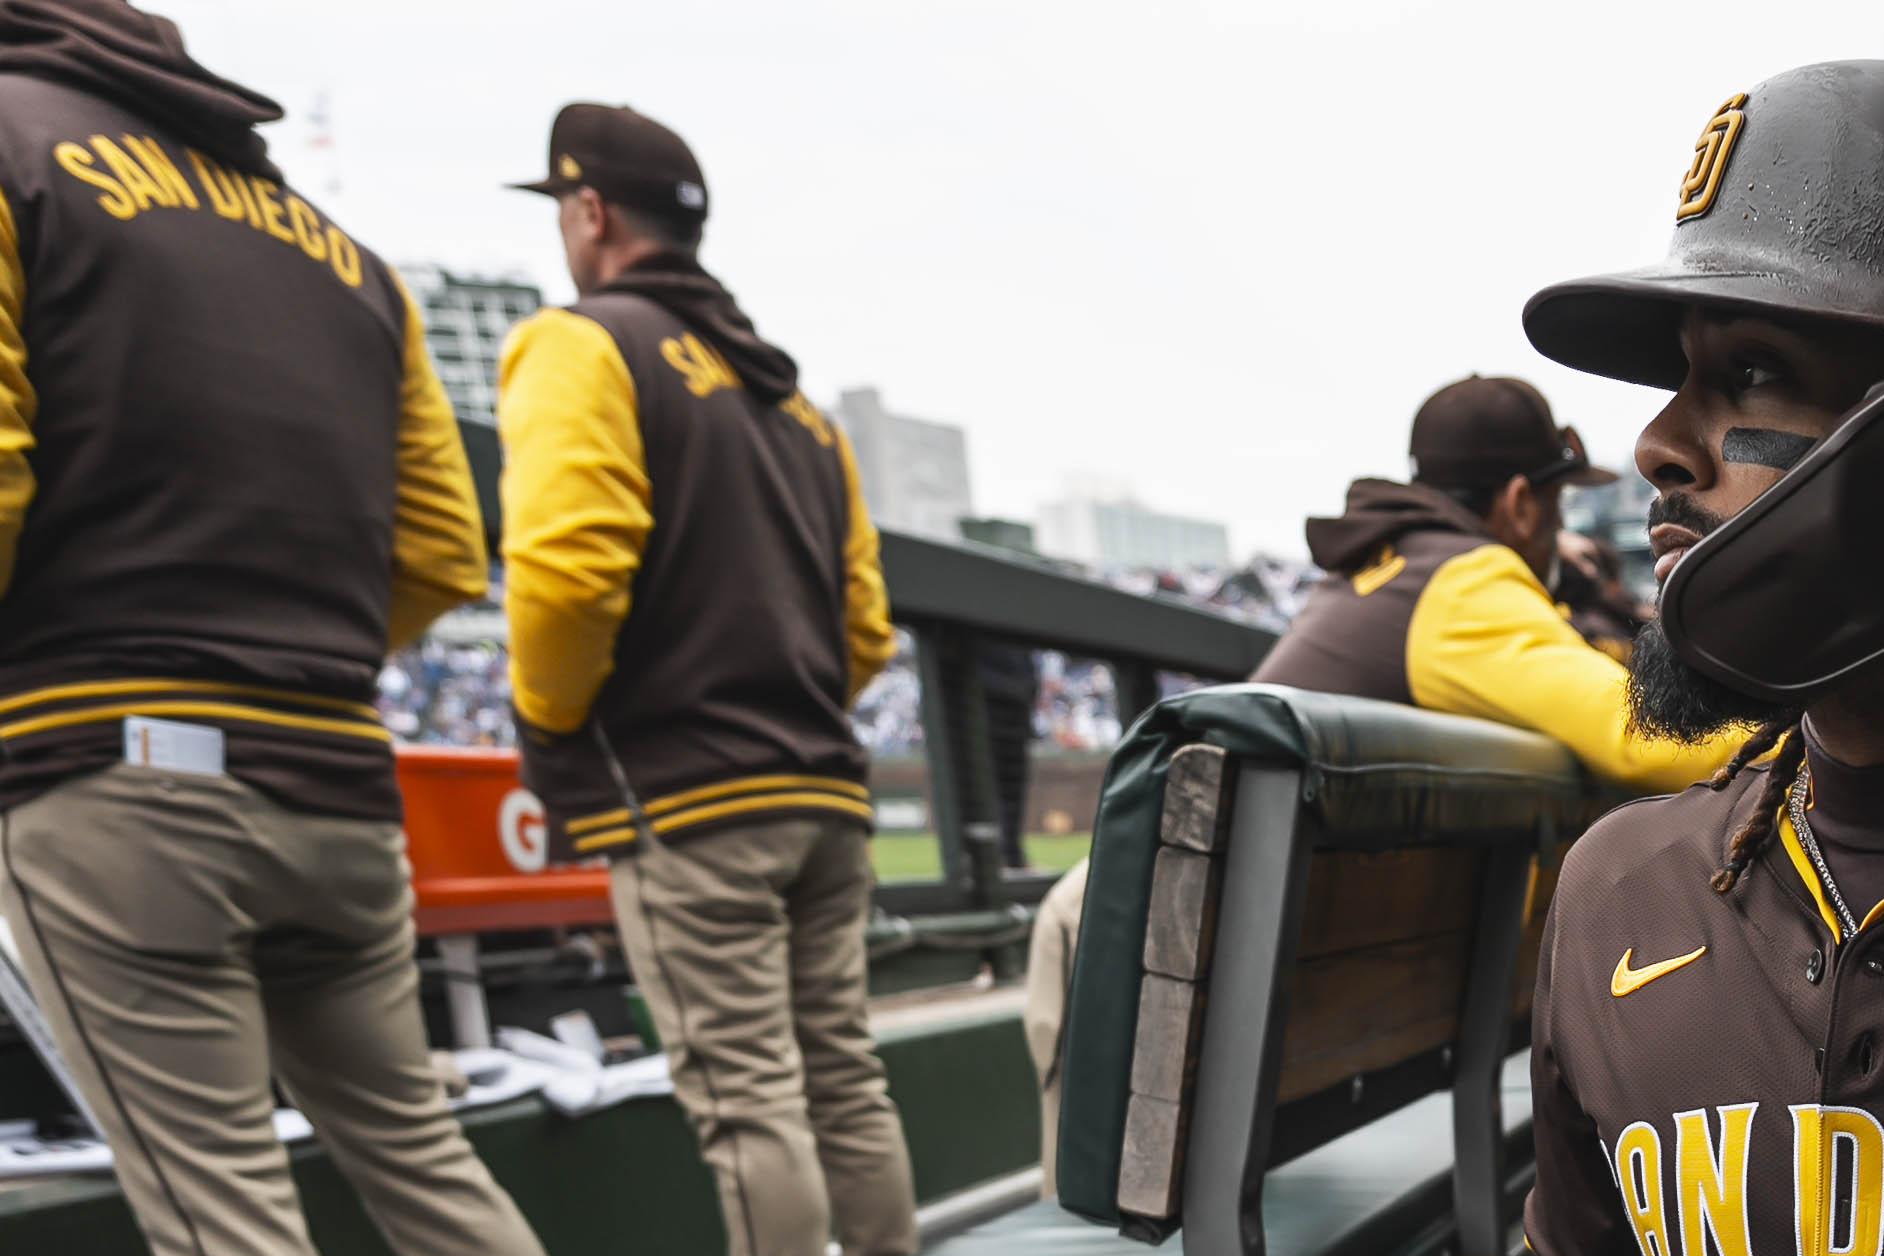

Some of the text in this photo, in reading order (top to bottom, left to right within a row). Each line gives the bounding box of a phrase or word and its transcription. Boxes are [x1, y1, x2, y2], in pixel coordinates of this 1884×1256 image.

[53, 133, 364, 289] SAN DIEGO
[497, 787, 550, 876] G
